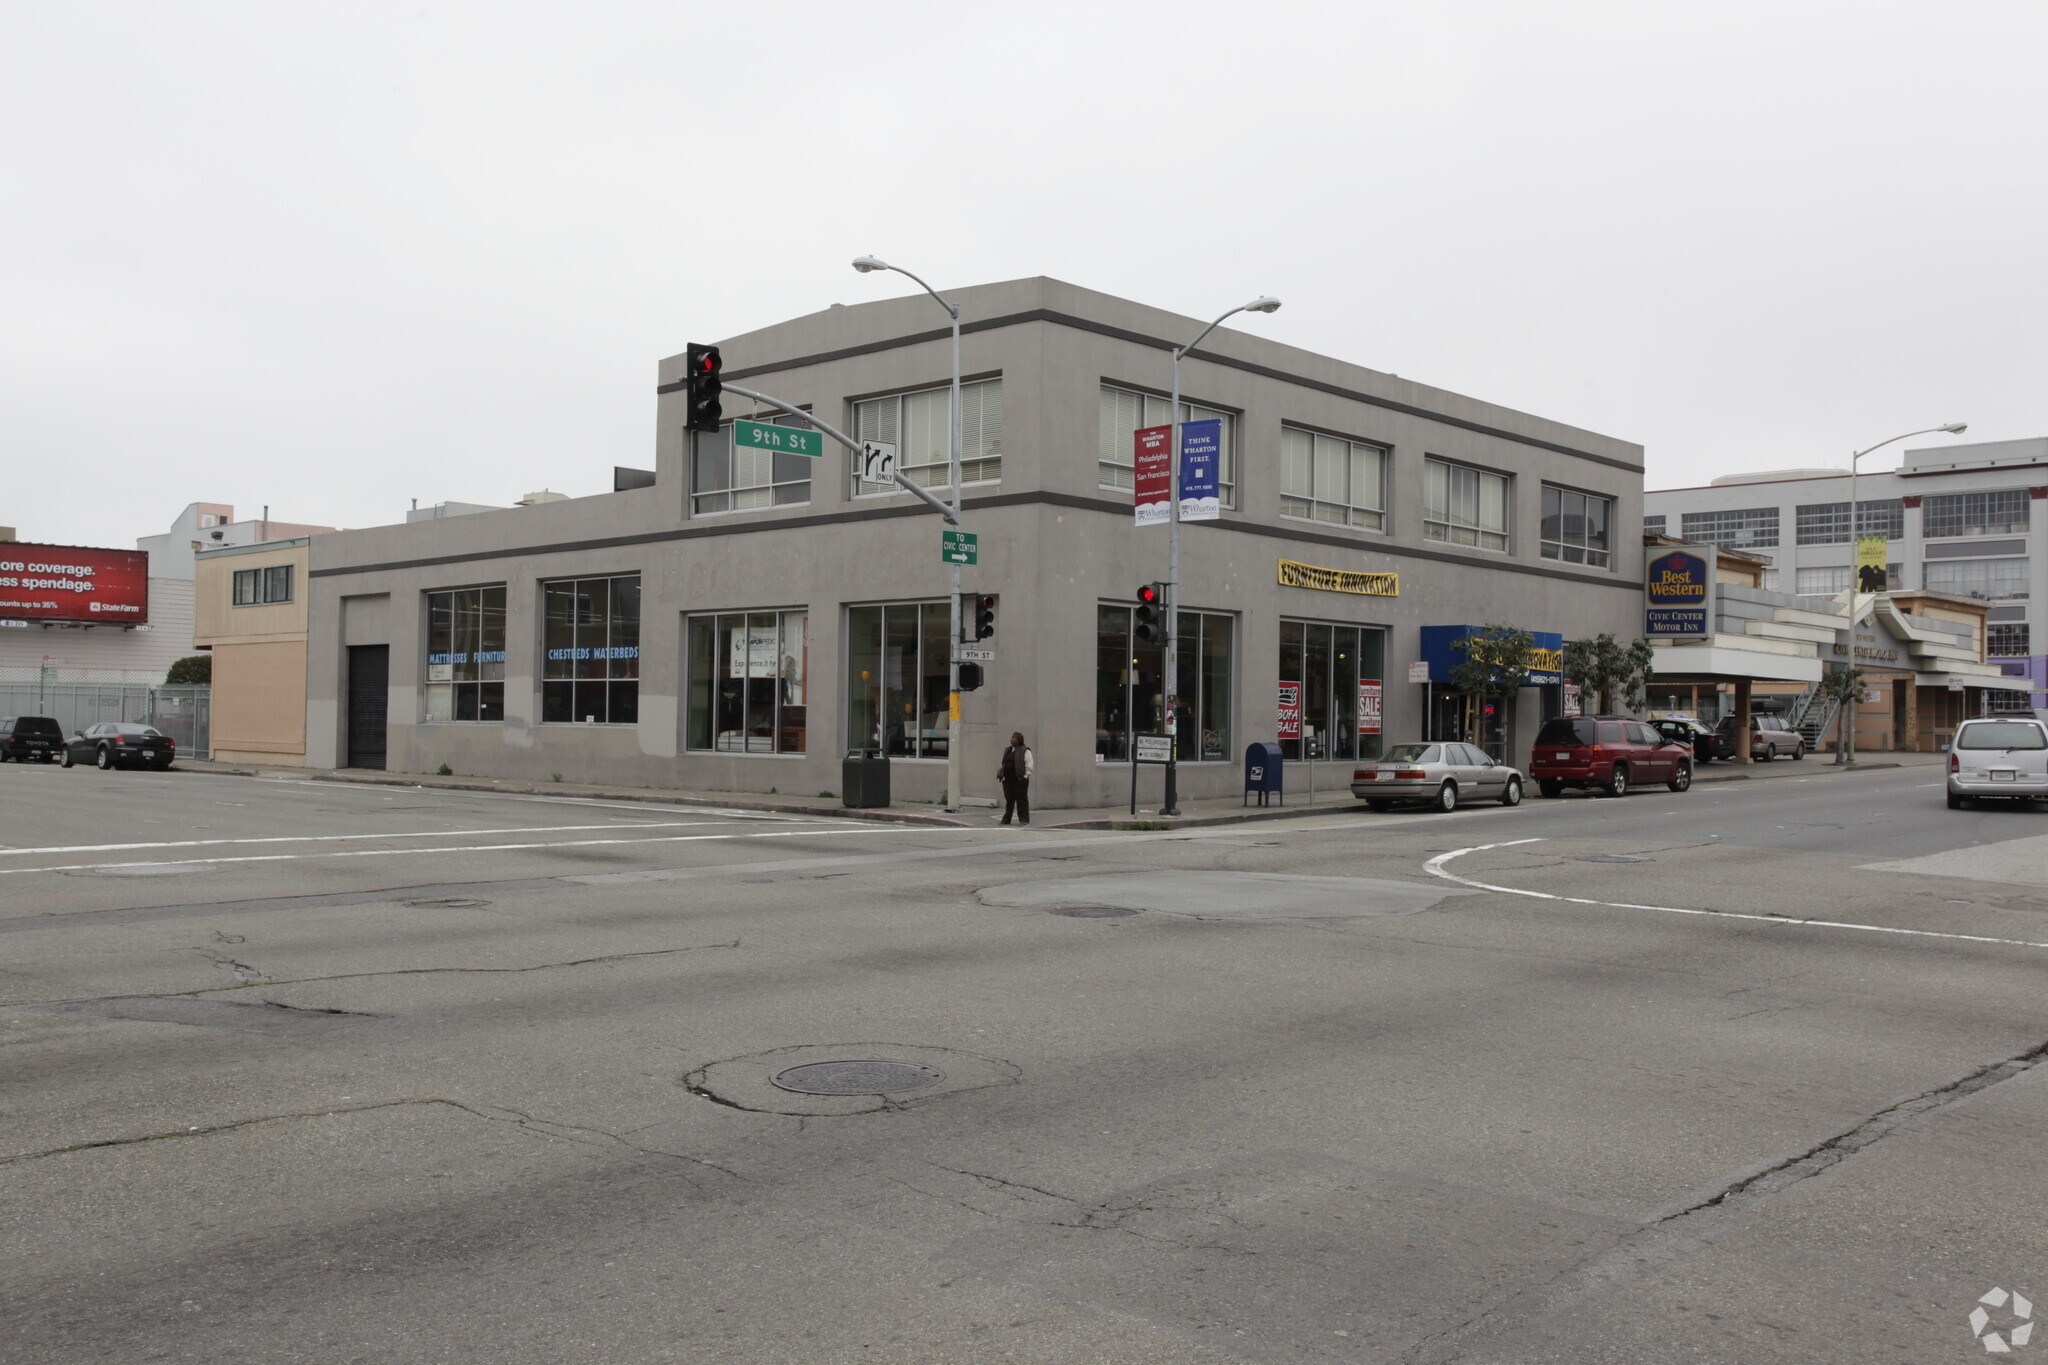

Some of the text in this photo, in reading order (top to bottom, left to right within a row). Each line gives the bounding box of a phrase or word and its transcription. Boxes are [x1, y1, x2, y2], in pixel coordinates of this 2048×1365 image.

[752, 428, 807, 450] 9th St
[1146, 440, 1160, 448] MBA
[1184, 446, 1216, 454] WHARTON
[1138, 453, 1168, 463] Philadelphia
[877, 473, 893, 482] ONLY
[1137, 470, 1171, 481] San Francisco
[1145, 508, 1171, 517] Wharton
[1189, 504, 1217, 513] Wharton
[956, 533, 965, 543] TO
[943, 541, 977, 553] CIVIC CENTER
[0, 561, 96, 577] ore coverage.
[1280, 563, 1397, 596] FURNITURE INNOVATION
[1661, 569, 1692, 584] Best
[22, 578, 96, 593] spendage.
[1650, 580, 1704, 596] Western
[21, 601, 32, 610] up
[41, 601, 58, 609] 35%
[1648, 611, 1704, 620] CIVIC CENTER
[1653, 622, 1699, 632] MOTOR INN
[548, 647, 590, 660] CHESTBEDS
[1359, 696, 1381, 716] SALE
[1277, 708, 1299, 721] SOFA
[1277, 721, 1299, 733] SALE
